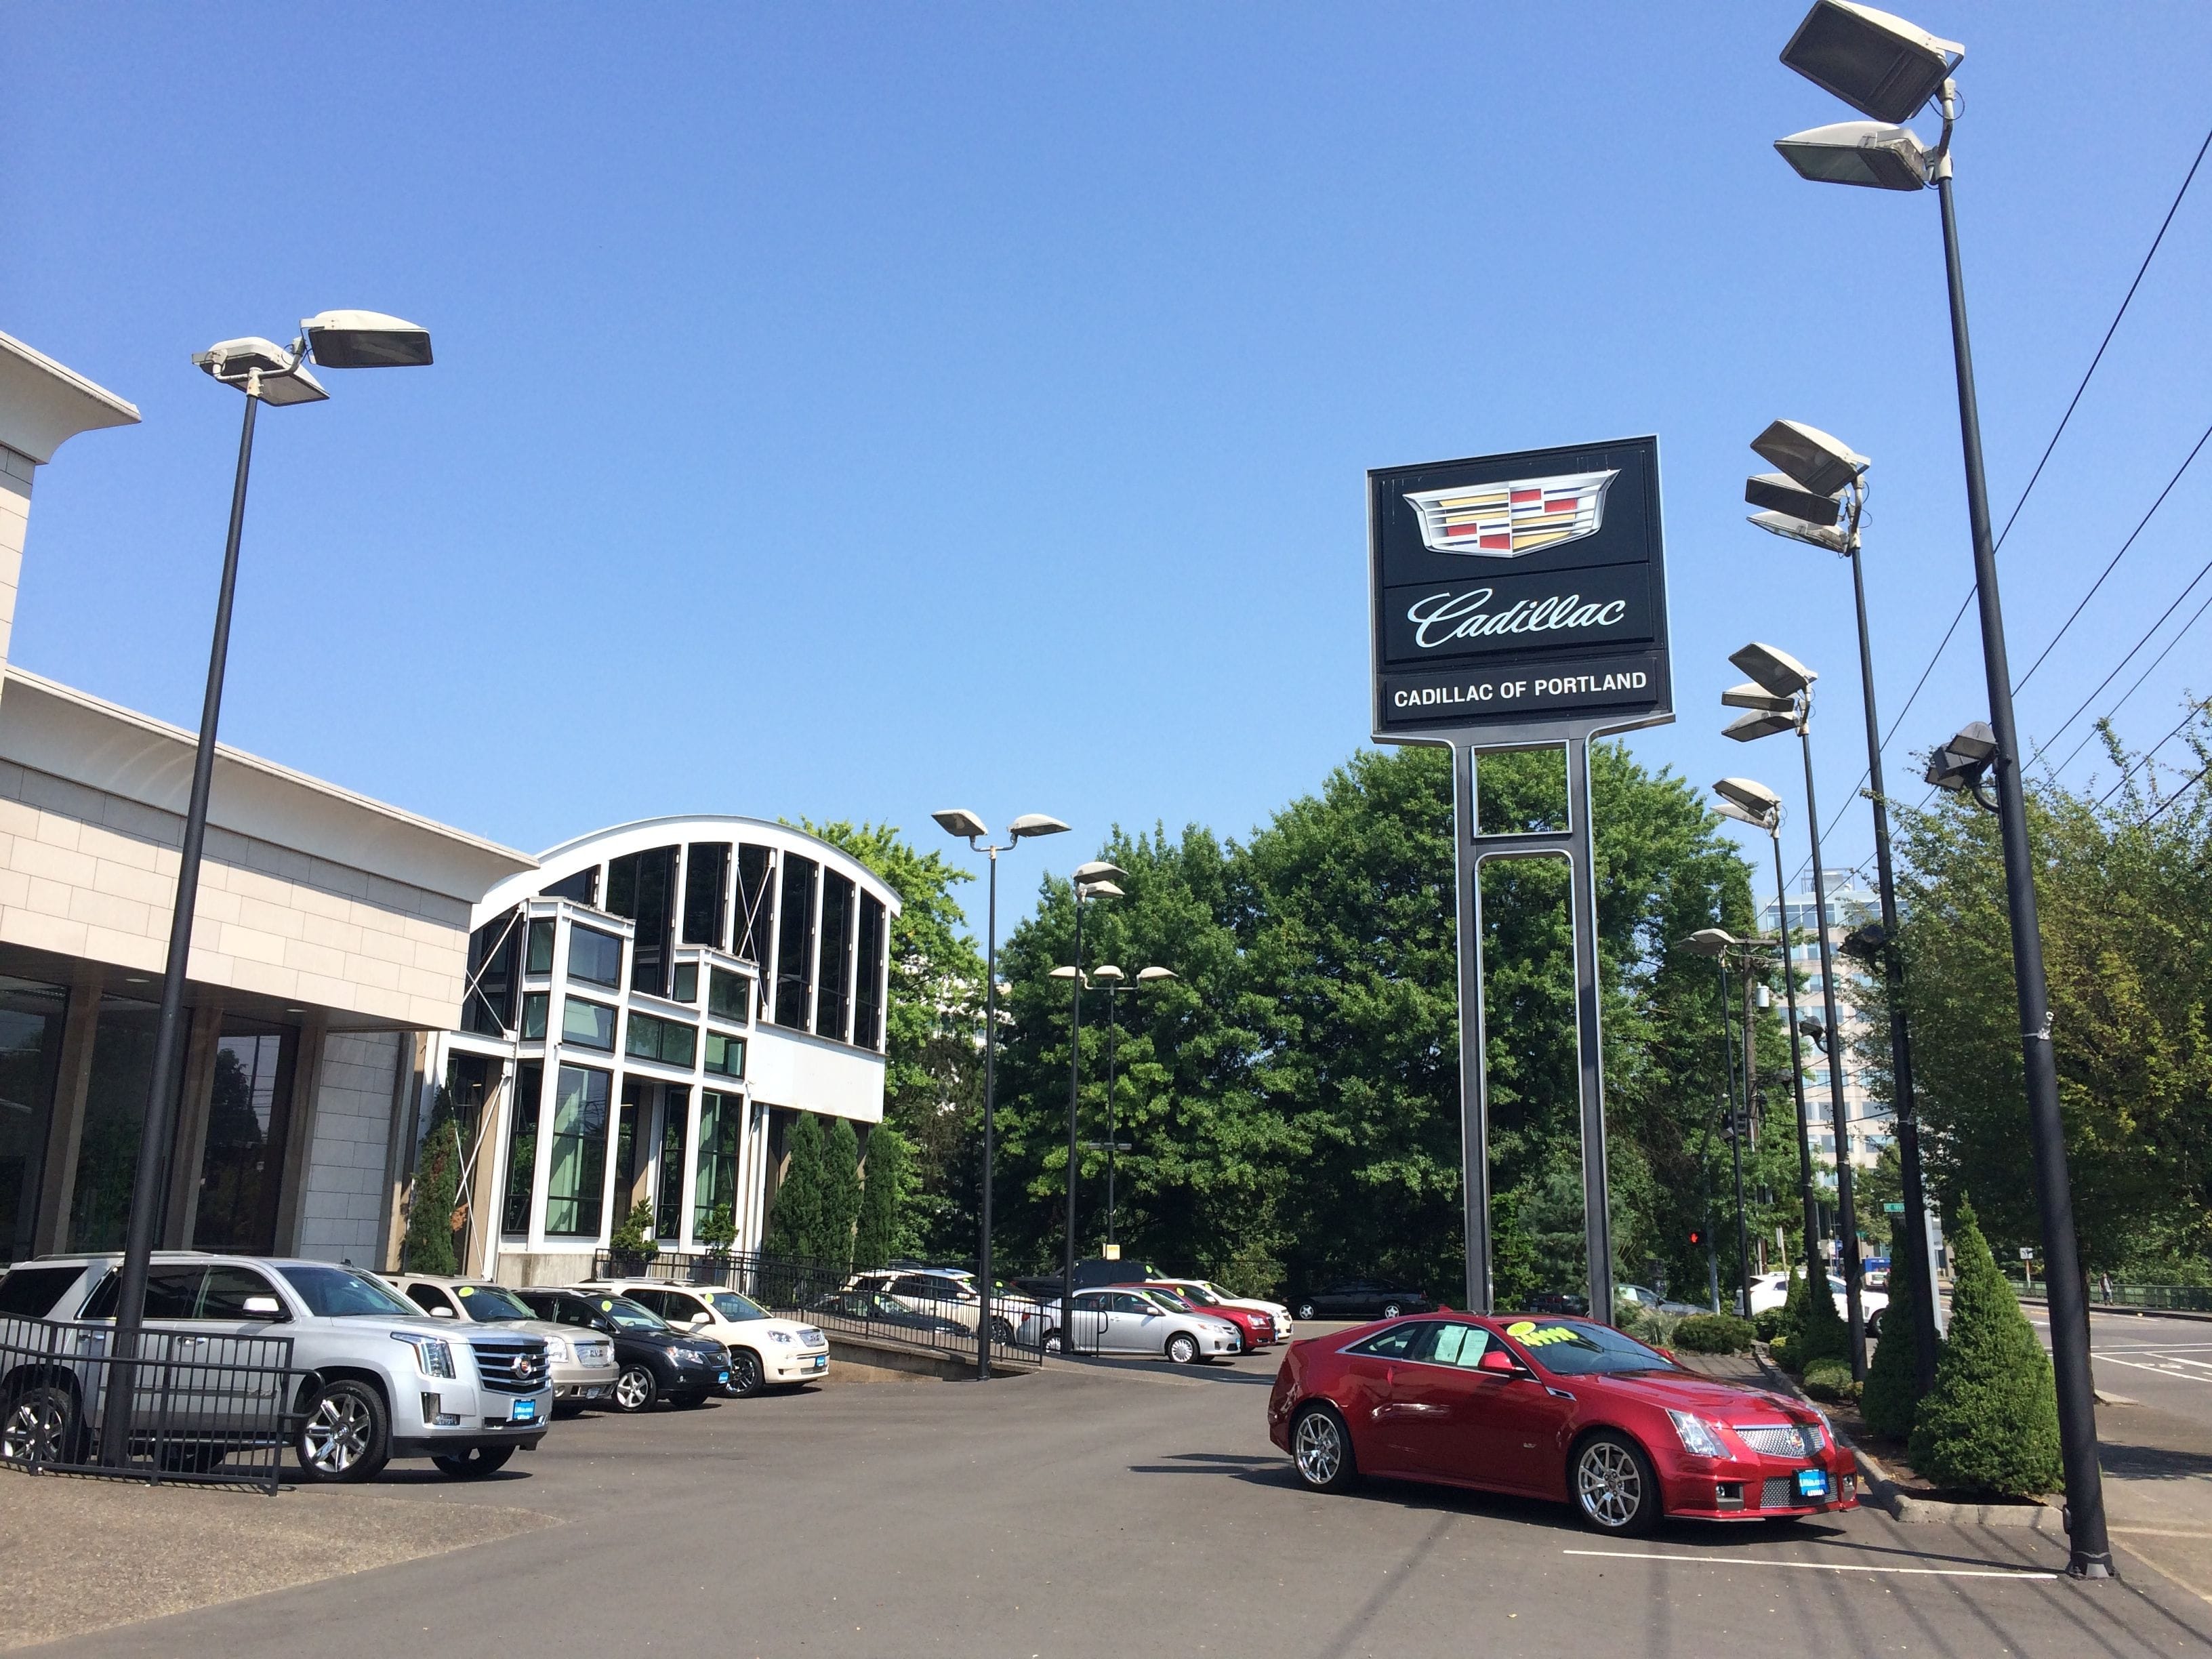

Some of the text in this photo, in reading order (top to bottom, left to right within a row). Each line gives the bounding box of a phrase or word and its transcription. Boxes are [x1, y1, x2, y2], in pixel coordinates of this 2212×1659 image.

[1408, 588, 1626, 648] Cadillac
[1394, 672, 1647, 708] CADILLAC OF PORTLAND
